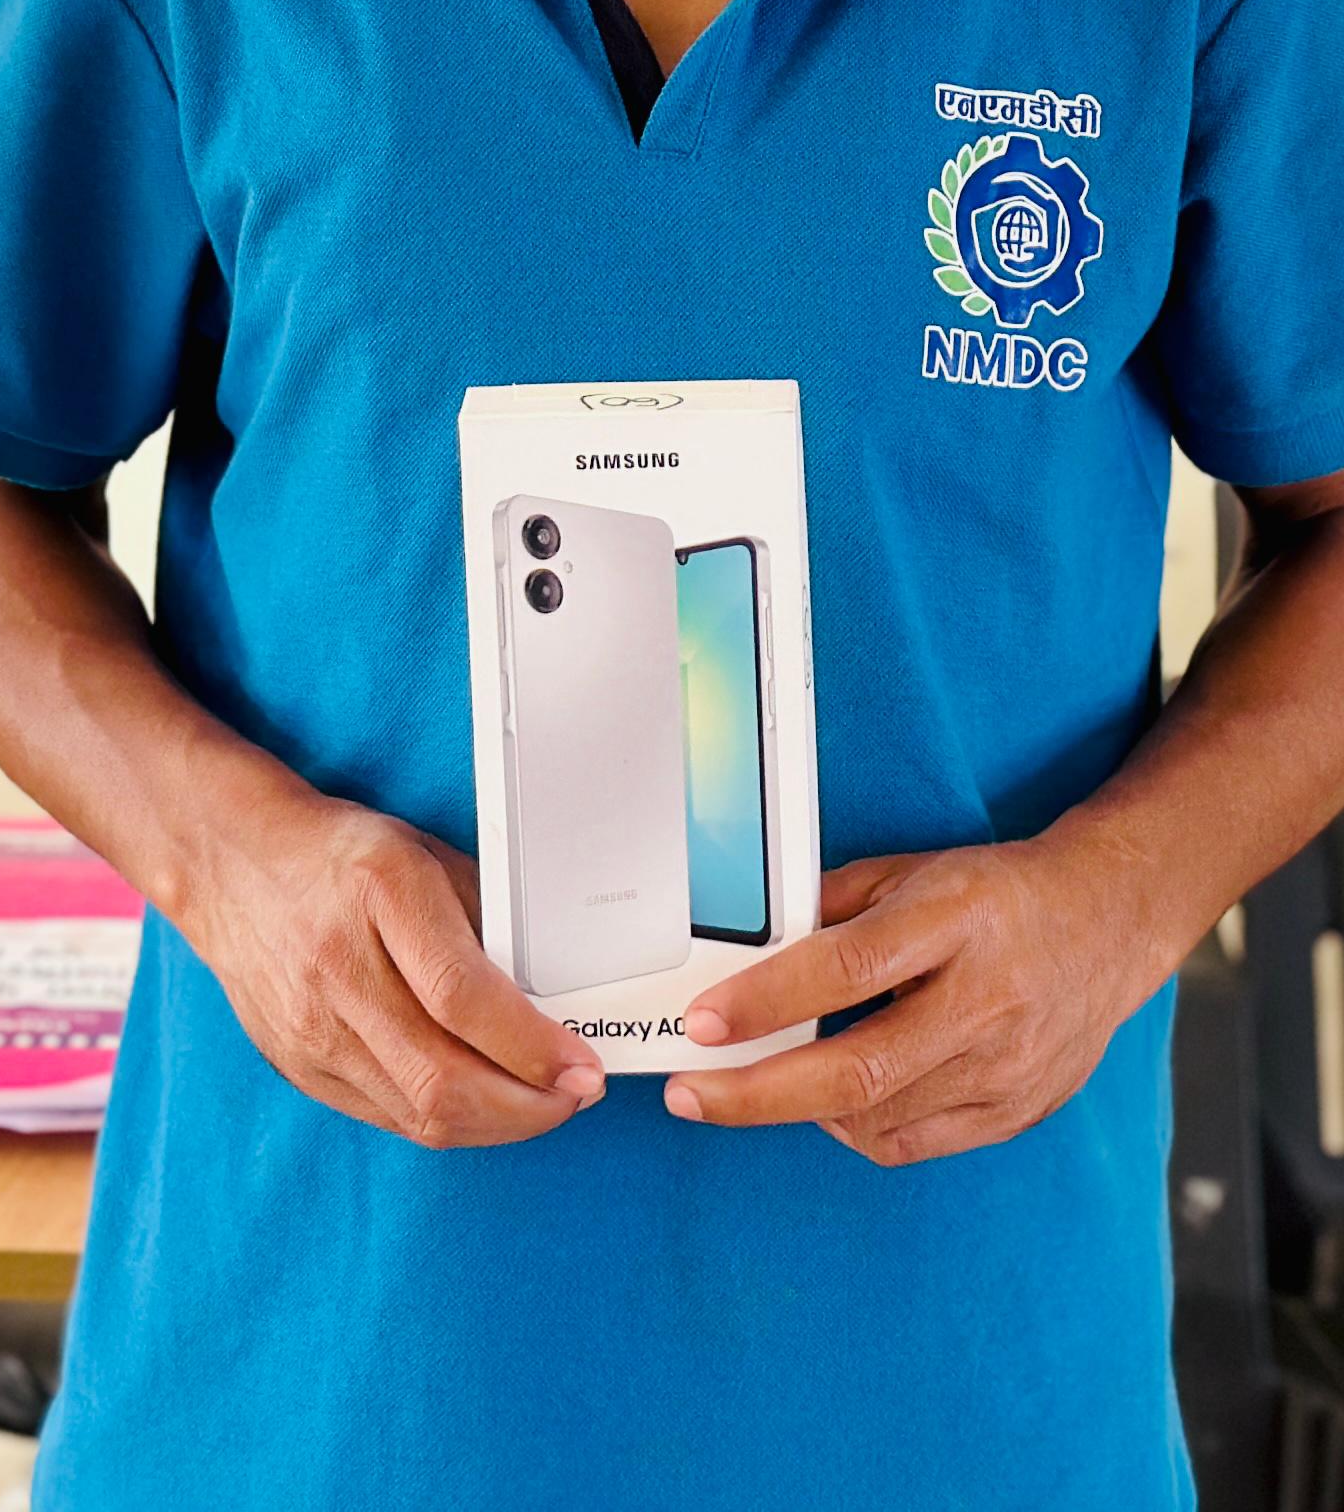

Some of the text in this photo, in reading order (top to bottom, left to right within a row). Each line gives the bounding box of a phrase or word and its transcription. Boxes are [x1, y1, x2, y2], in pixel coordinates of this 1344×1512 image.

[935, 83, 1102, 138] एनएमडीसी
[922, 325, 1088, 391] NMDC
[575, 451, 681, 471] SAMSUNG
